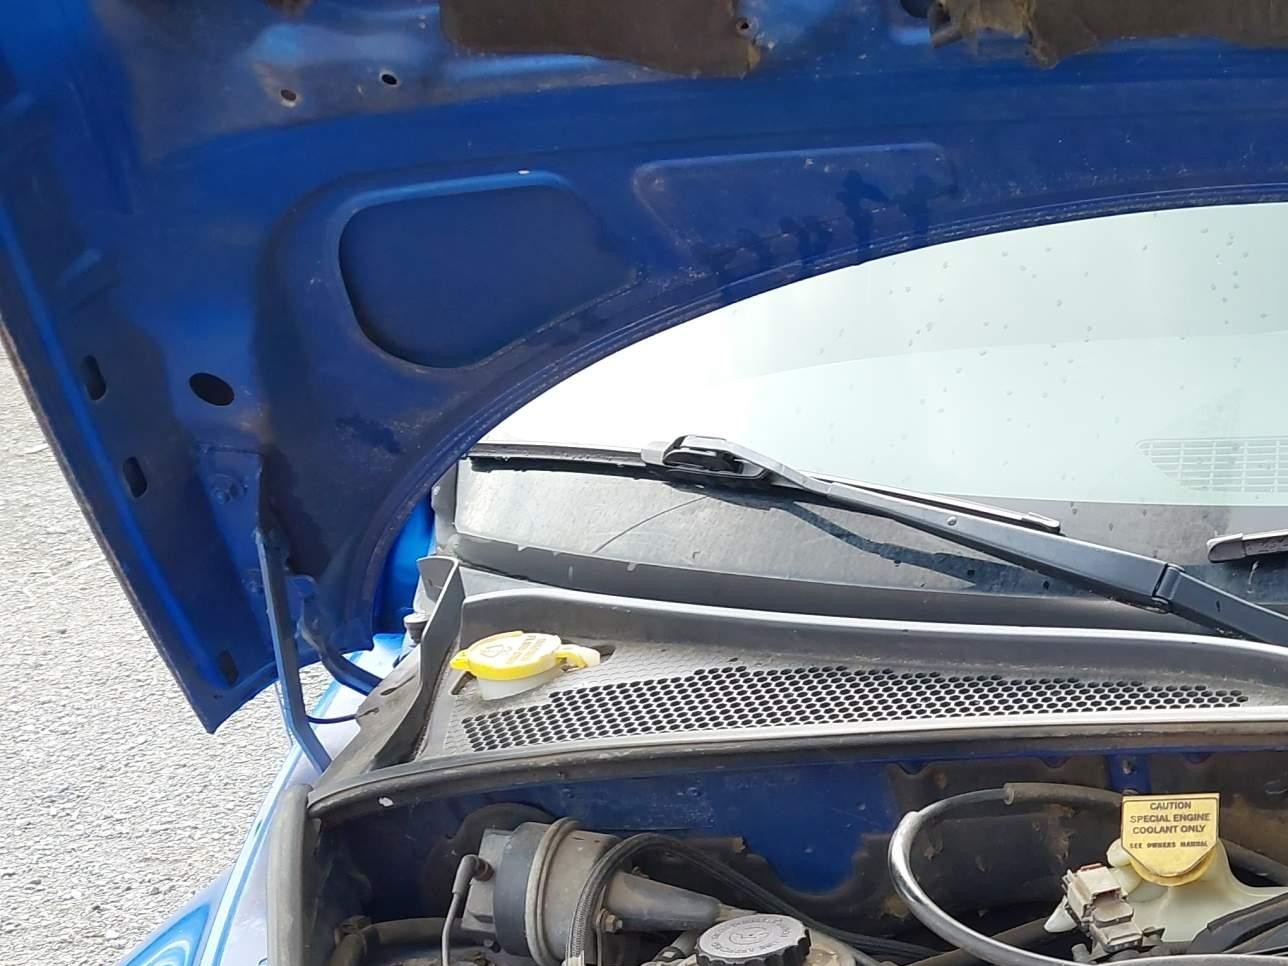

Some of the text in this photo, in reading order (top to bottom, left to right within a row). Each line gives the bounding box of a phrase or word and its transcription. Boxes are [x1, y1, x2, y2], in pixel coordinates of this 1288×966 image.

[1150, 801, 1192, 810] CAUTION
[1130, 812, 1211, 824] SPECIAL ENGINE
[1132, 824, 1207, 835] COOLANT ONLY
